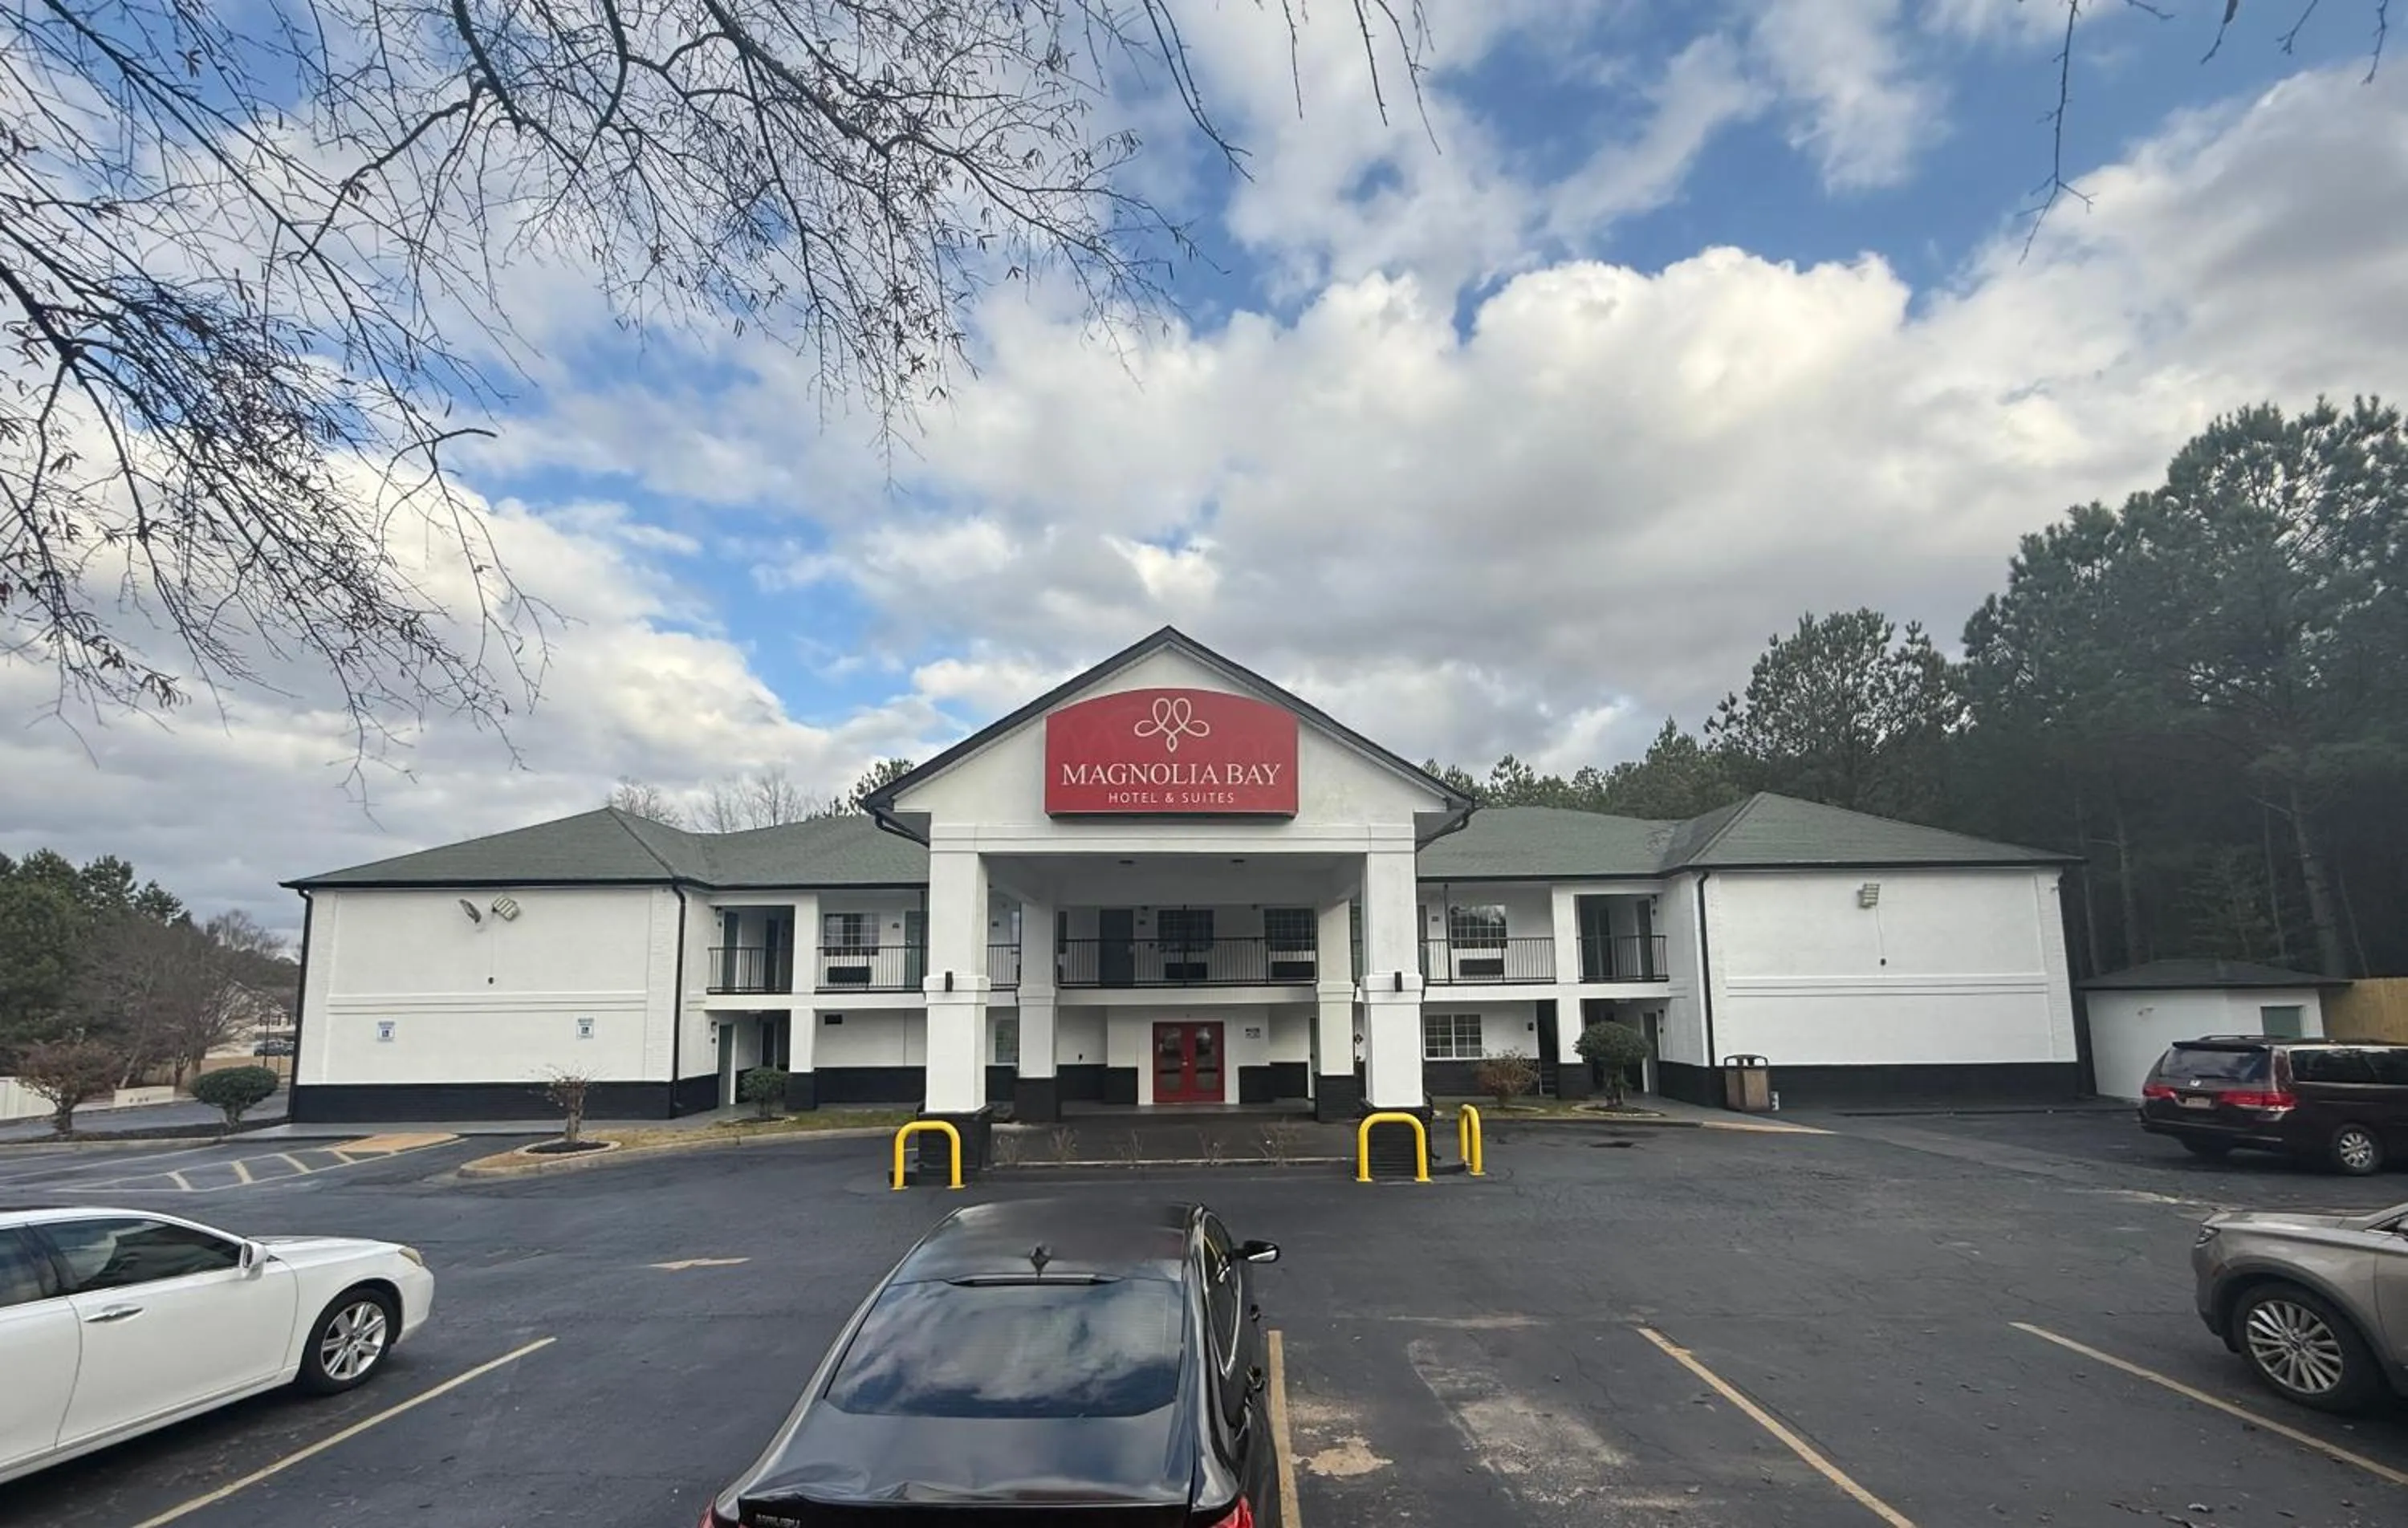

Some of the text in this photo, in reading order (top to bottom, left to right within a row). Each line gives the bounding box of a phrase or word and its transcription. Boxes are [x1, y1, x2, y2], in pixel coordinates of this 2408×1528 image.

[1060, 763, 1283, 786] MAGNOLIA BAY
[1108, 792, 1235, 803] HOTEL & SUITES
